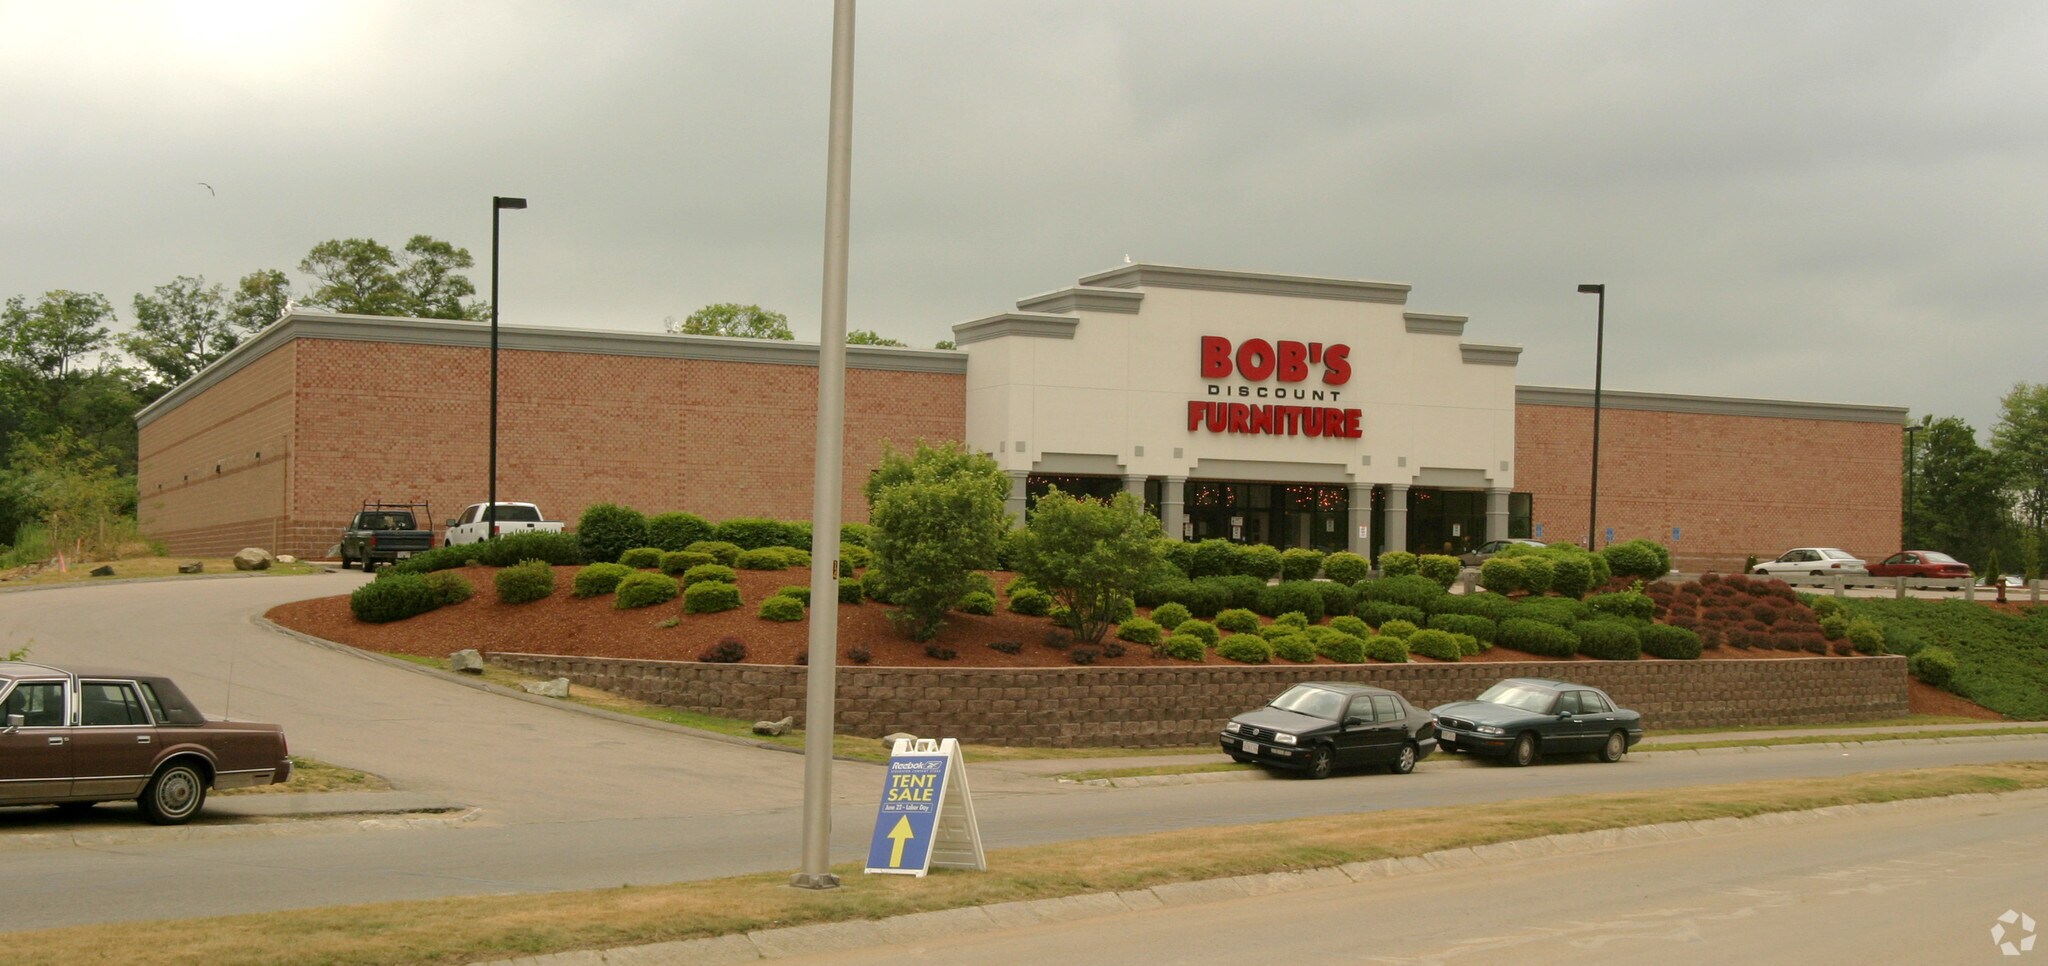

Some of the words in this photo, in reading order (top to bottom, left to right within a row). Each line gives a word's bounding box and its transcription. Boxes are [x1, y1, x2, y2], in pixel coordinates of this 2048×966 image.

[1201, 335, 1352, 385] BOB'S
[1208, 384, 1340, 401] DISCOUNT
[1187, 400, 1363, 438] FURNITURE
[892, 774, 936, 788] TENT
[888, 788, 934, 801] SALE
